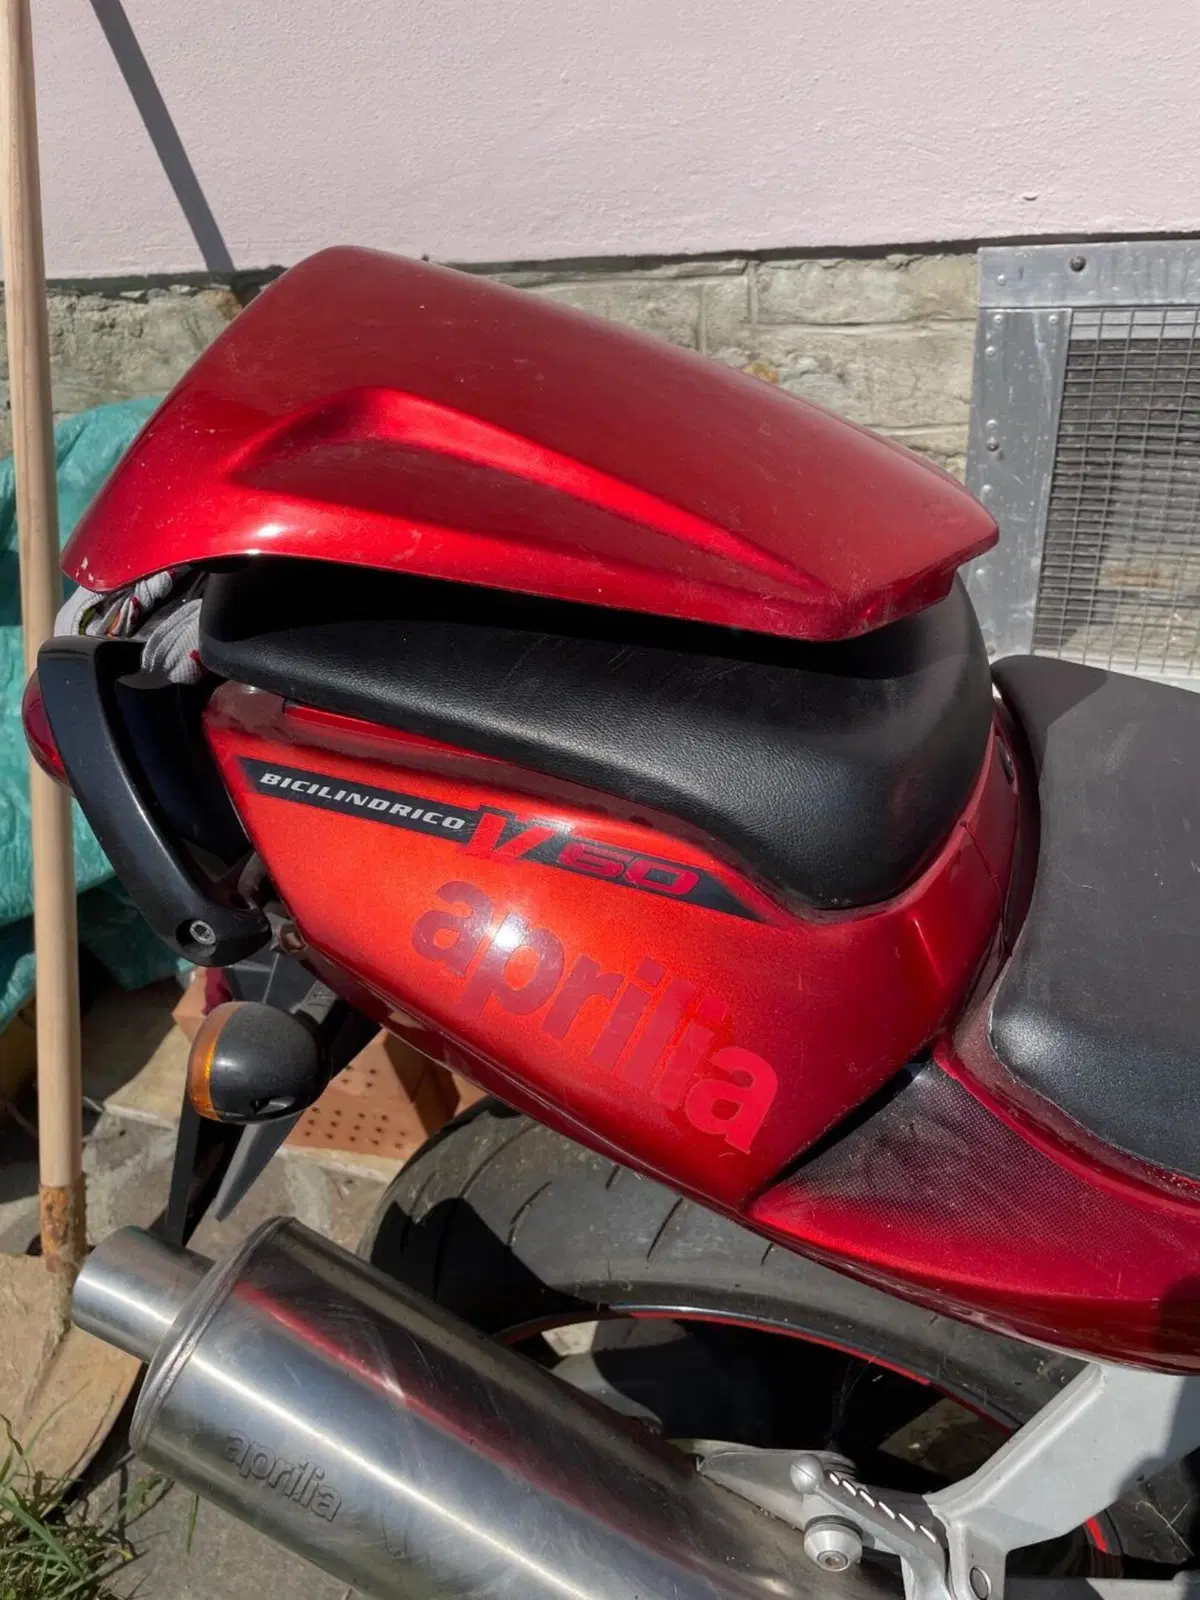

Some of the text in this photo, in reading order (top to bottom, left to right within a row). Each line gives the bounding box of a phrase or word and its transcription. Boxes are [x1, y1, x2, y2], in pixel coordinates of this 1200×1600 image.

[259, 772, 466, 830] BICILINDRICO
[411, 880, 779, 1155] aprilia
[222, 1429, 342, 1523] aprilia
